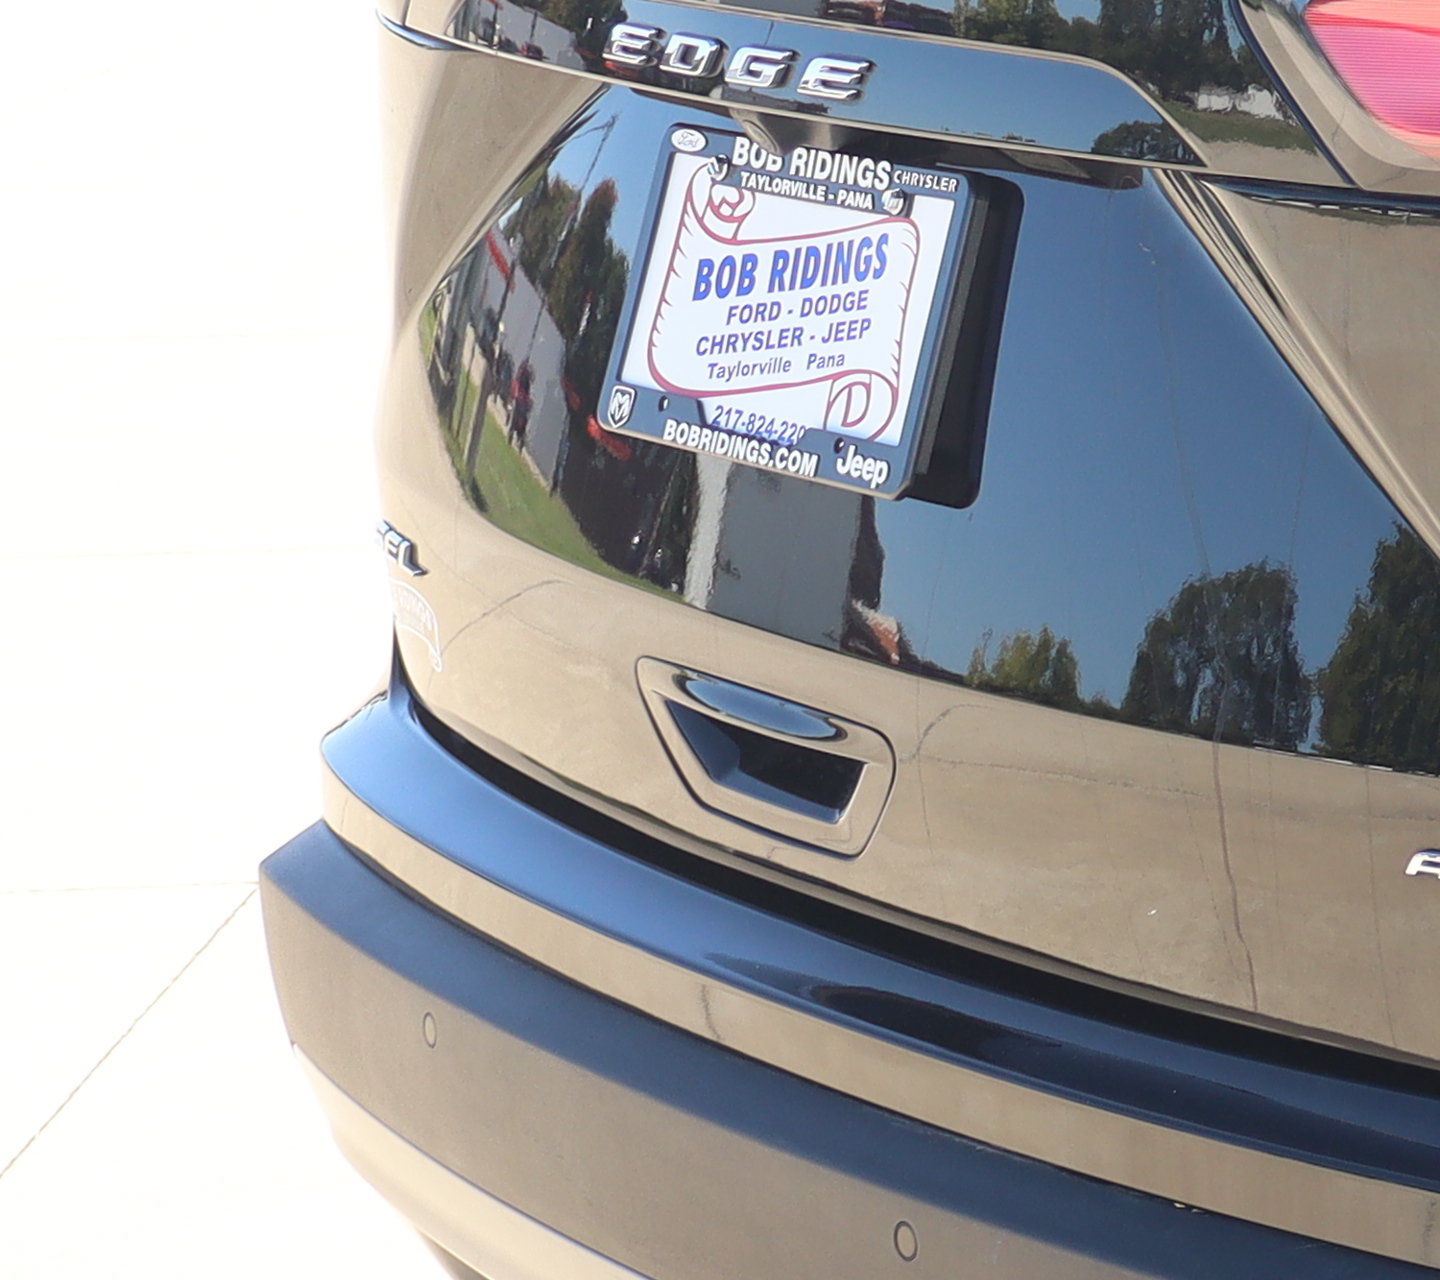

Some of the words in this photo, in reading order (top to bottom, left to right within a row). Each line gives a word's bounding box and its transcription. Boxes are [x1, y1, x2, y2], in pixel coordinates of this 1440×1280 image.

[602, 22, 876, 100] EDGE
[789, 146, 893, 191] RIDINGS
[893, 169, 958, 193] CHRYSLER
[740, 171, 827, 202] TAYLORVILLE
[836, 189, 874, 210] PANA
[692, 253, 758, 301] BOB
[767, 232, 889, 293] RIDINGS
[726, 300, 781, 326] FORD
[799, 288, 869, 318] DODGE
[695, 326, 804, 357] CHRYSLER
[821, 317, 872, 344] JEEP
[707, 356, 792, 383] Taylorville
[806, 353, 846, 370] Pana
[662, 419, 820, 478] BOBRIDINGS.COM
[836, 444, 889, 489] Jeep
